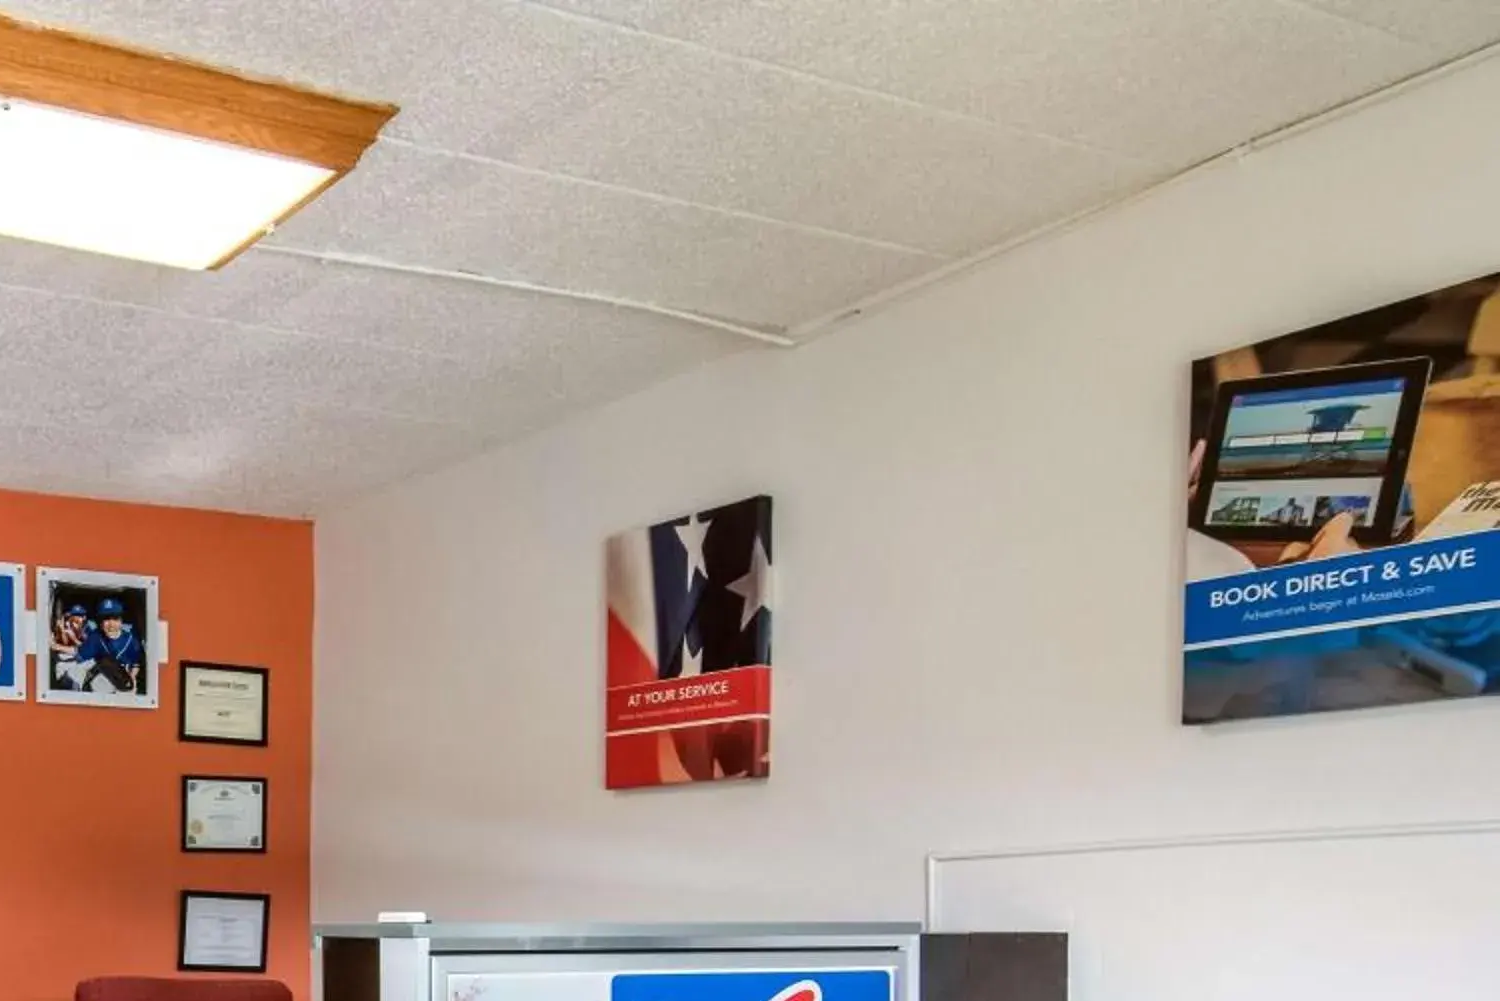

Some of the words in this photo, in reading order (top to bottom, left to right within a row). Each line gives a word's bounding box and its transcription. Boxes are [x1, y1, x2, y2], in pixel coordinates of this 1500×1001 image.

[1210, 580, 1278, 608] BOOK
[1285, 565, 1374, 597] DIRECT
[1381, 561, 1401, 581] &
[1409, 547, 1477, 577] SAVE
[627, 694, 641, 708] AT
[644, 689, 675, 706] YOUR
[679, 679, 730, 701] SERVICE
